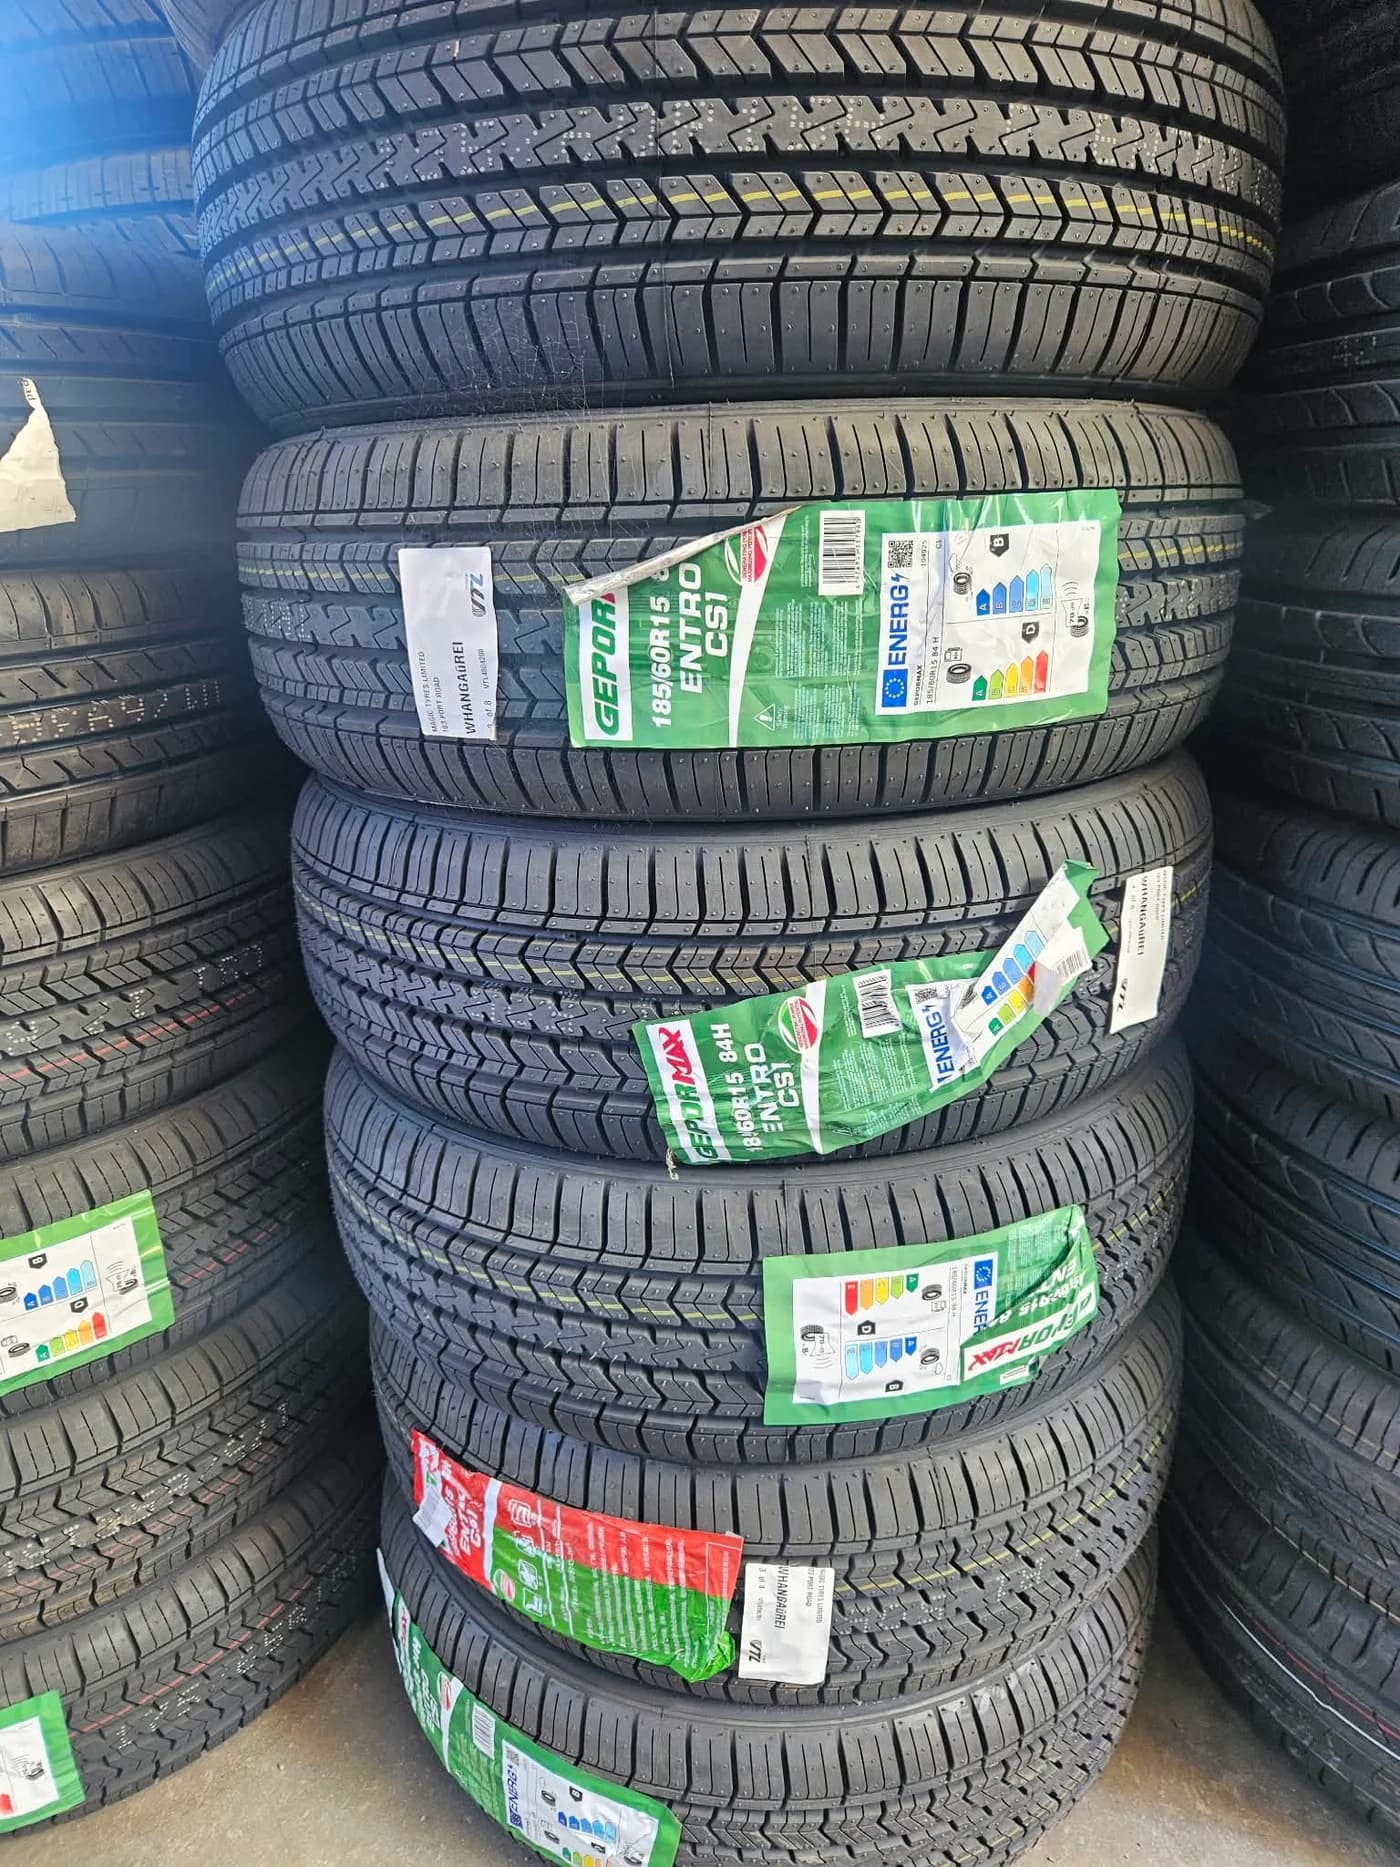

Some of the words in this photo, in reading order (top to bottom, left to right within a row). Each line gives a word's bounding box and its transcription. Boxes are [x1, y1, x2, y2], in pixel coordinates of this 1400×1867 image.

[649, 596, 672, 728] 185/60R15
[679, 562, 703, 694] ENTRO
[888, 584, 909, 666] ENERG
[929, 645, 939, 657] 84
[710, 1023, 738, 1064] 84H
[926, 1010, 955, 1073] ENERG
[658, 1027, 719, 1159] GEPORMAX
[744, 1042, 784, 1133] ENTRO
[974, 1290, 989, 1333] ENER
